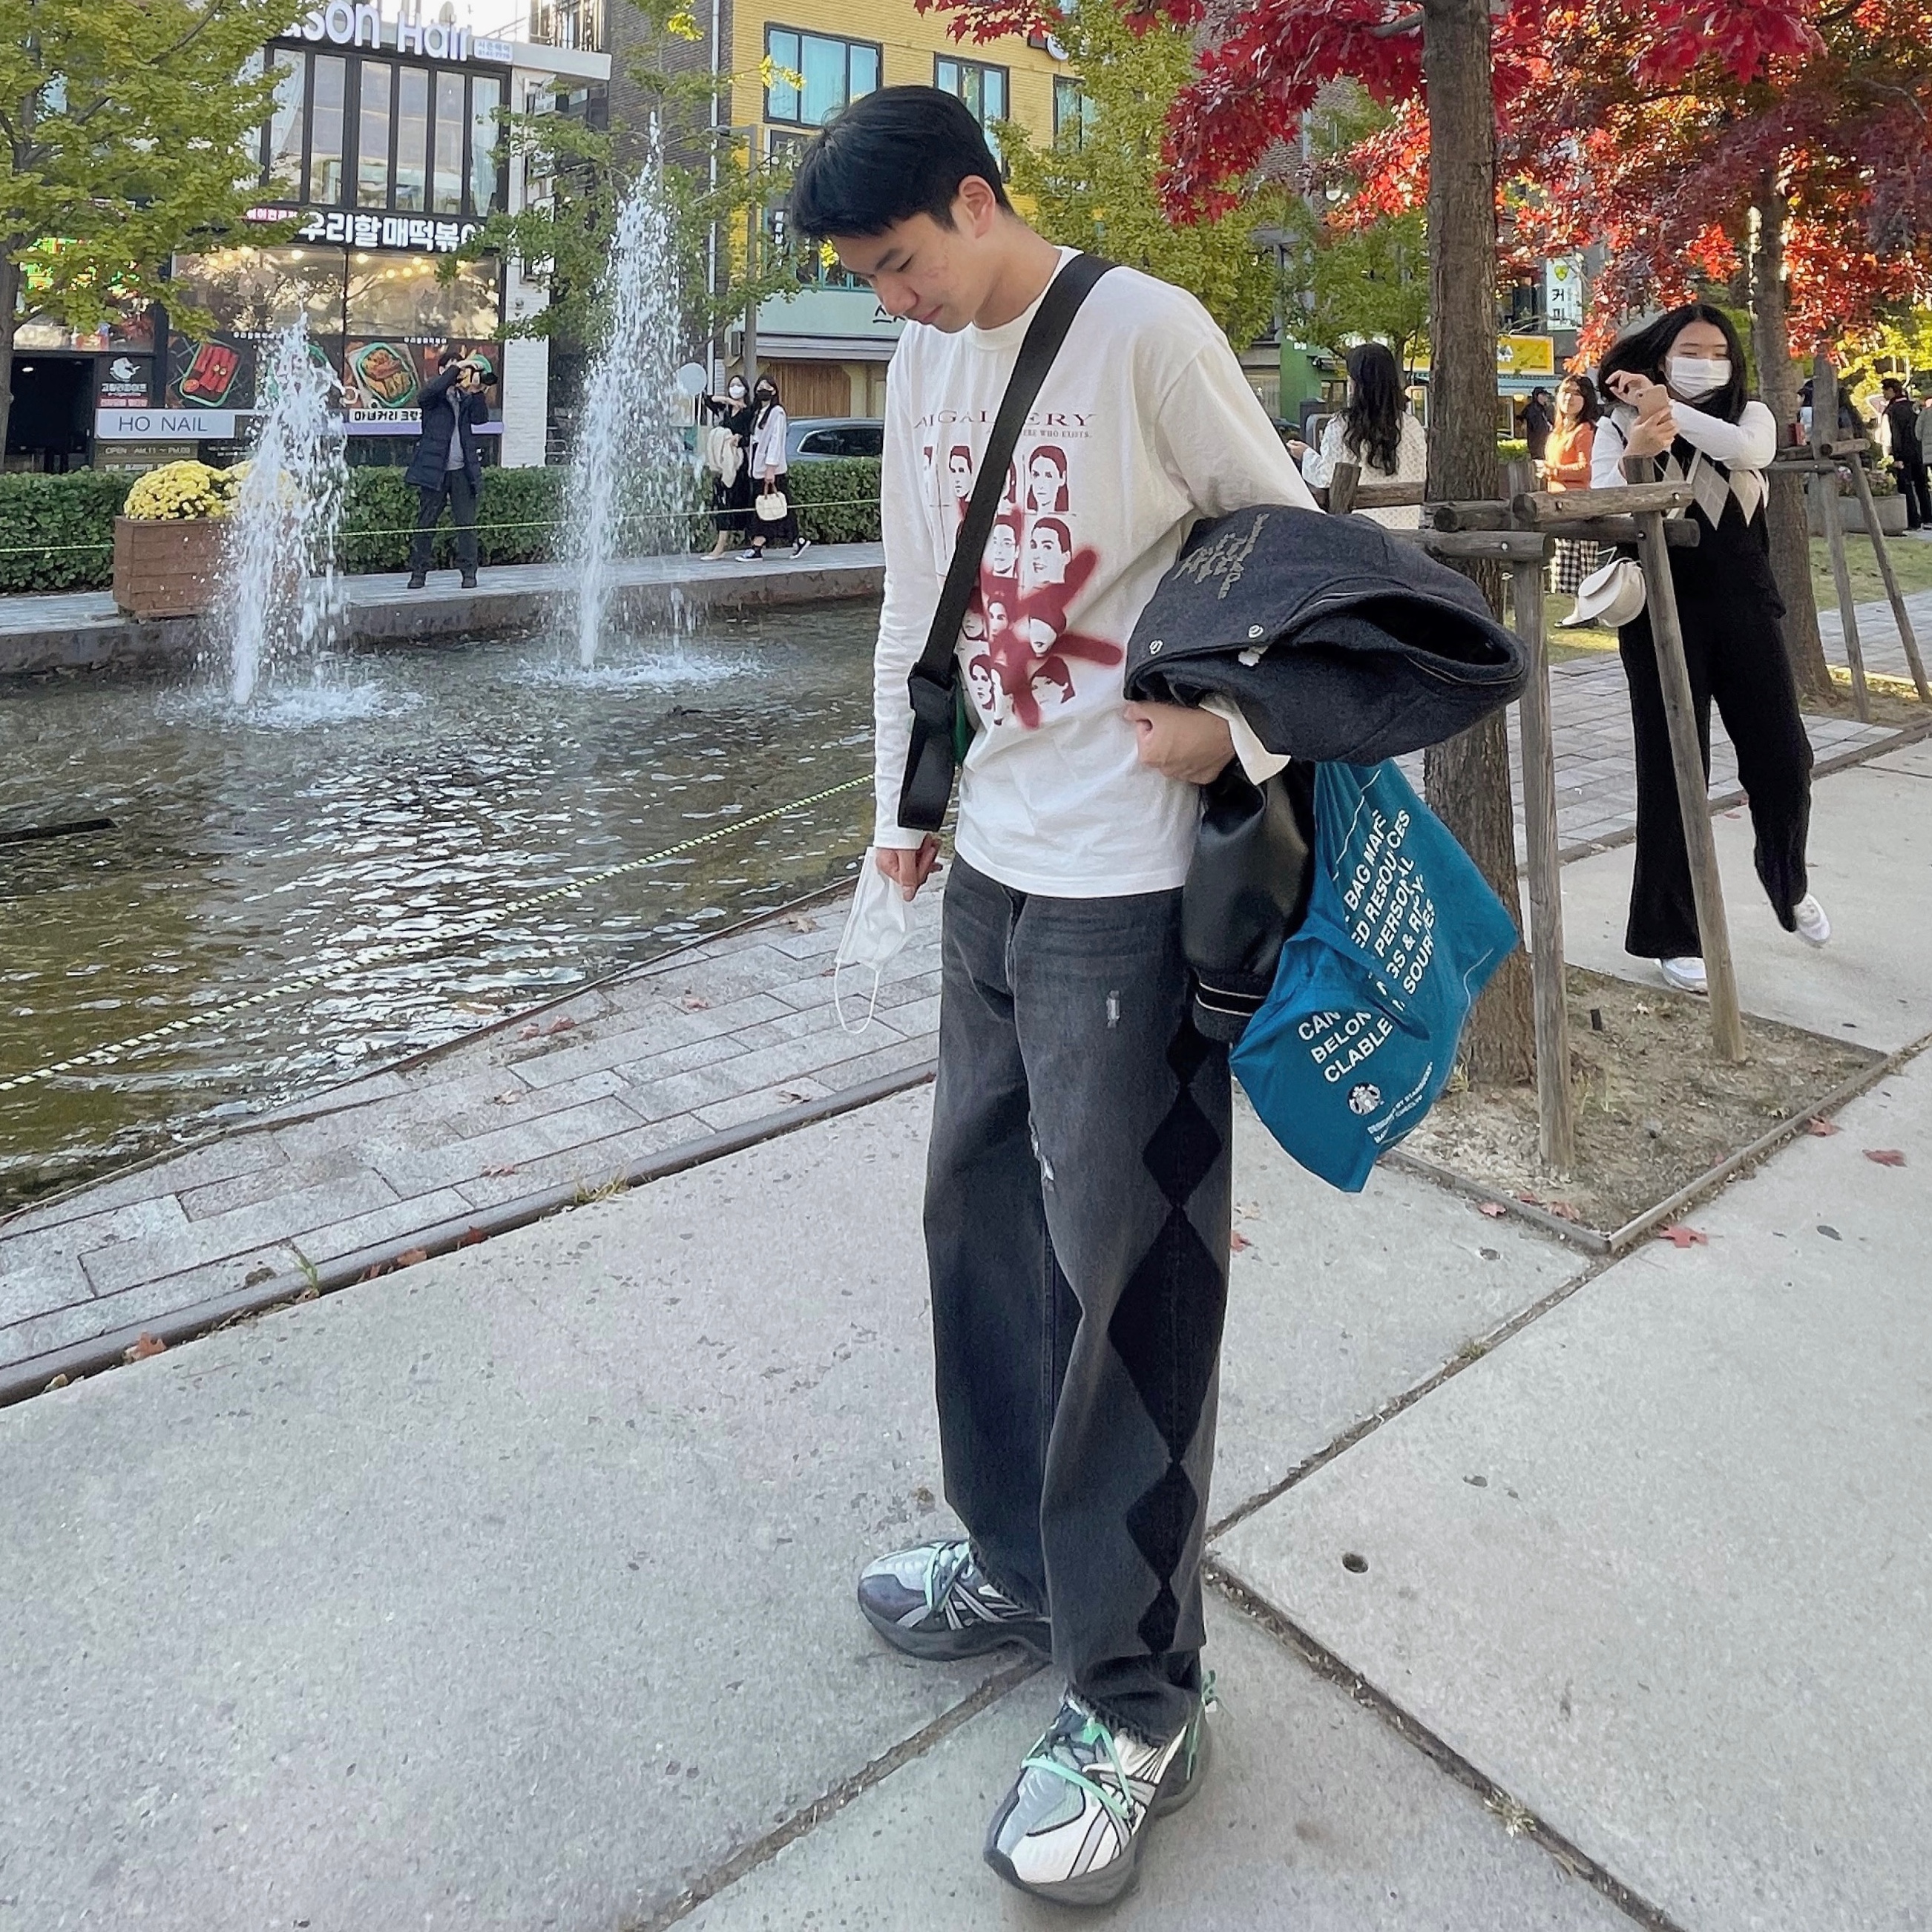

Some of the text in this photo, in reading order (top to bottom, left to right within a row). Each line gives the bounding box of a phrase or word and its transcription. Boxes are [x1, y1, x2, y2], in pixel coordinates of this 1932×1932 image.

[397, 10, 472, 62] Hair
[119, 416, 208, 432] HO NAIL
[1344, 864, 1371, 911] BAG
[1324, 1017, 1393, 1082] CLABLE
